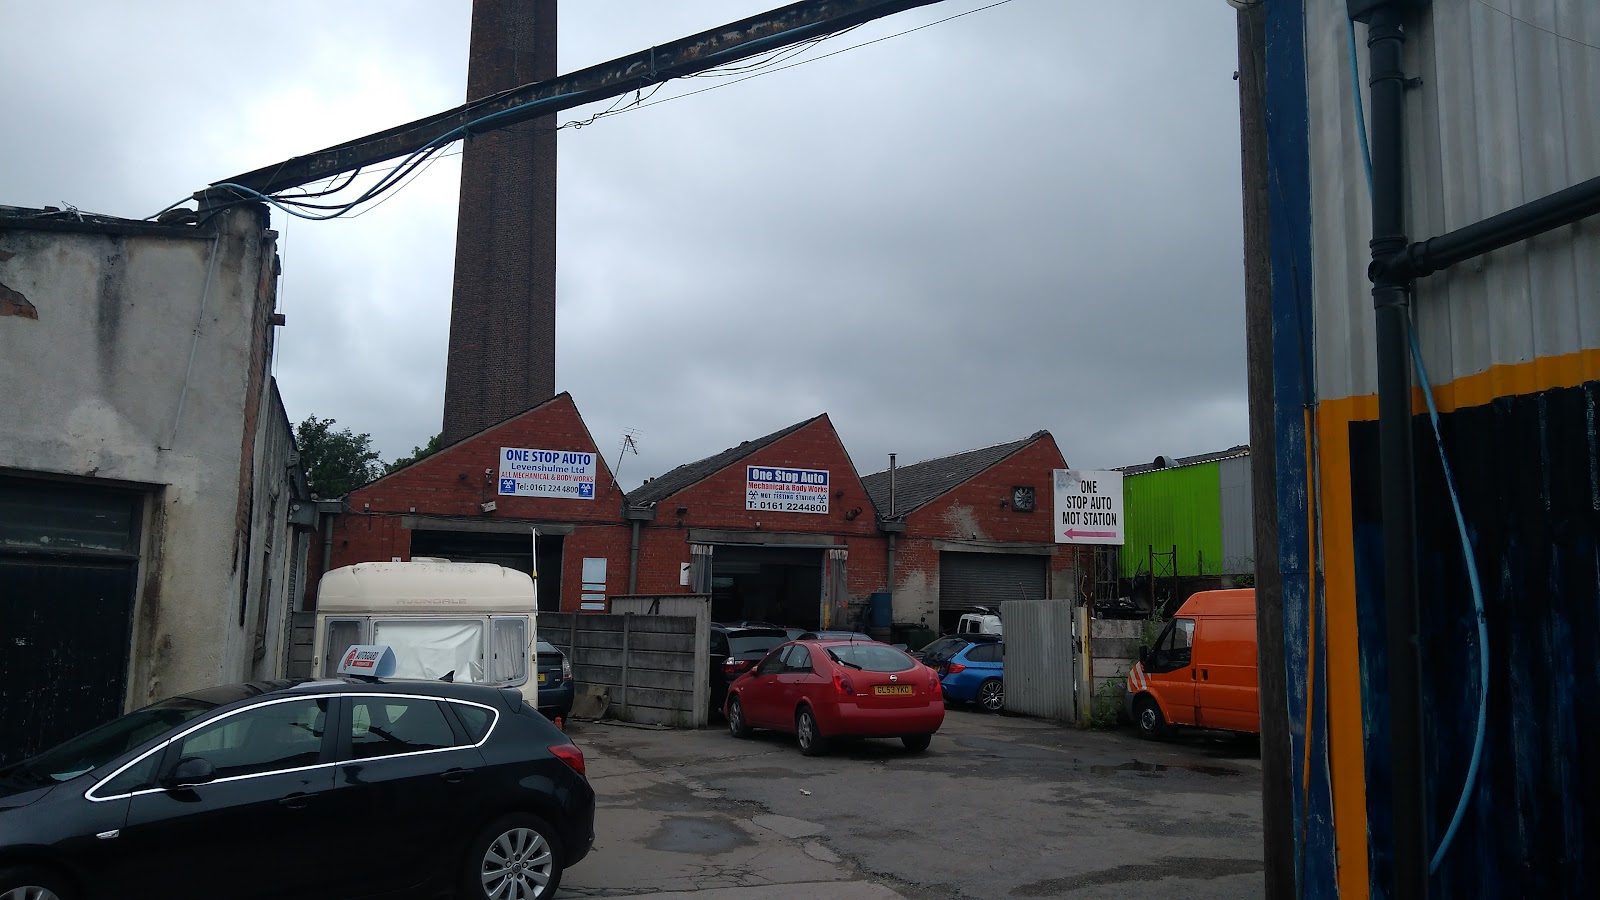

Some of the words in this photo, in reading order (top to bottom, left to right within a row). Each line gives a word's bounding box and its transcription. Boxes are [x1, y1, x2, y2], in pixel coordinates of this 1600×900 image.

[506, 449, 529, 461] ONE
[532, 451, 560, 463] STOP
[562, 453, 591, 465] AUTO
[511, 463, 569, 473] Levenshulme
[571, 466, 585, 474] Ltd
[513, 472, 550, 480] MECHANICAL
[556, 474, 572, 482] BODY
[752, 468, 772, 480] One
[775, 469, 799, 483] Stop
[800, 471, 824, 484] Auto
[516, 482, 529, 491] Tel:
[530, 483, 546, 491] 0161
[548, 484, 560, 492] 224
[561, 485, 579, 493] 4800
[748, 482, 785, 491] Mechanical
[791, 484, 807, 493] Body
[807, 485, 828, 493] Works
[1080, 480, 1097, 493] ONE
[748, 501, 757, 509] T:
[760, 501, 783, 510] 0161
[786, 502, 827, 512] 2244800
[1066, 495, 1088, 509] STOP
[1090, 496, 1112, 510] AUTO
[1062, 511, 1080, 525] MOT
[1083, 511, 1117, 526] STATION
